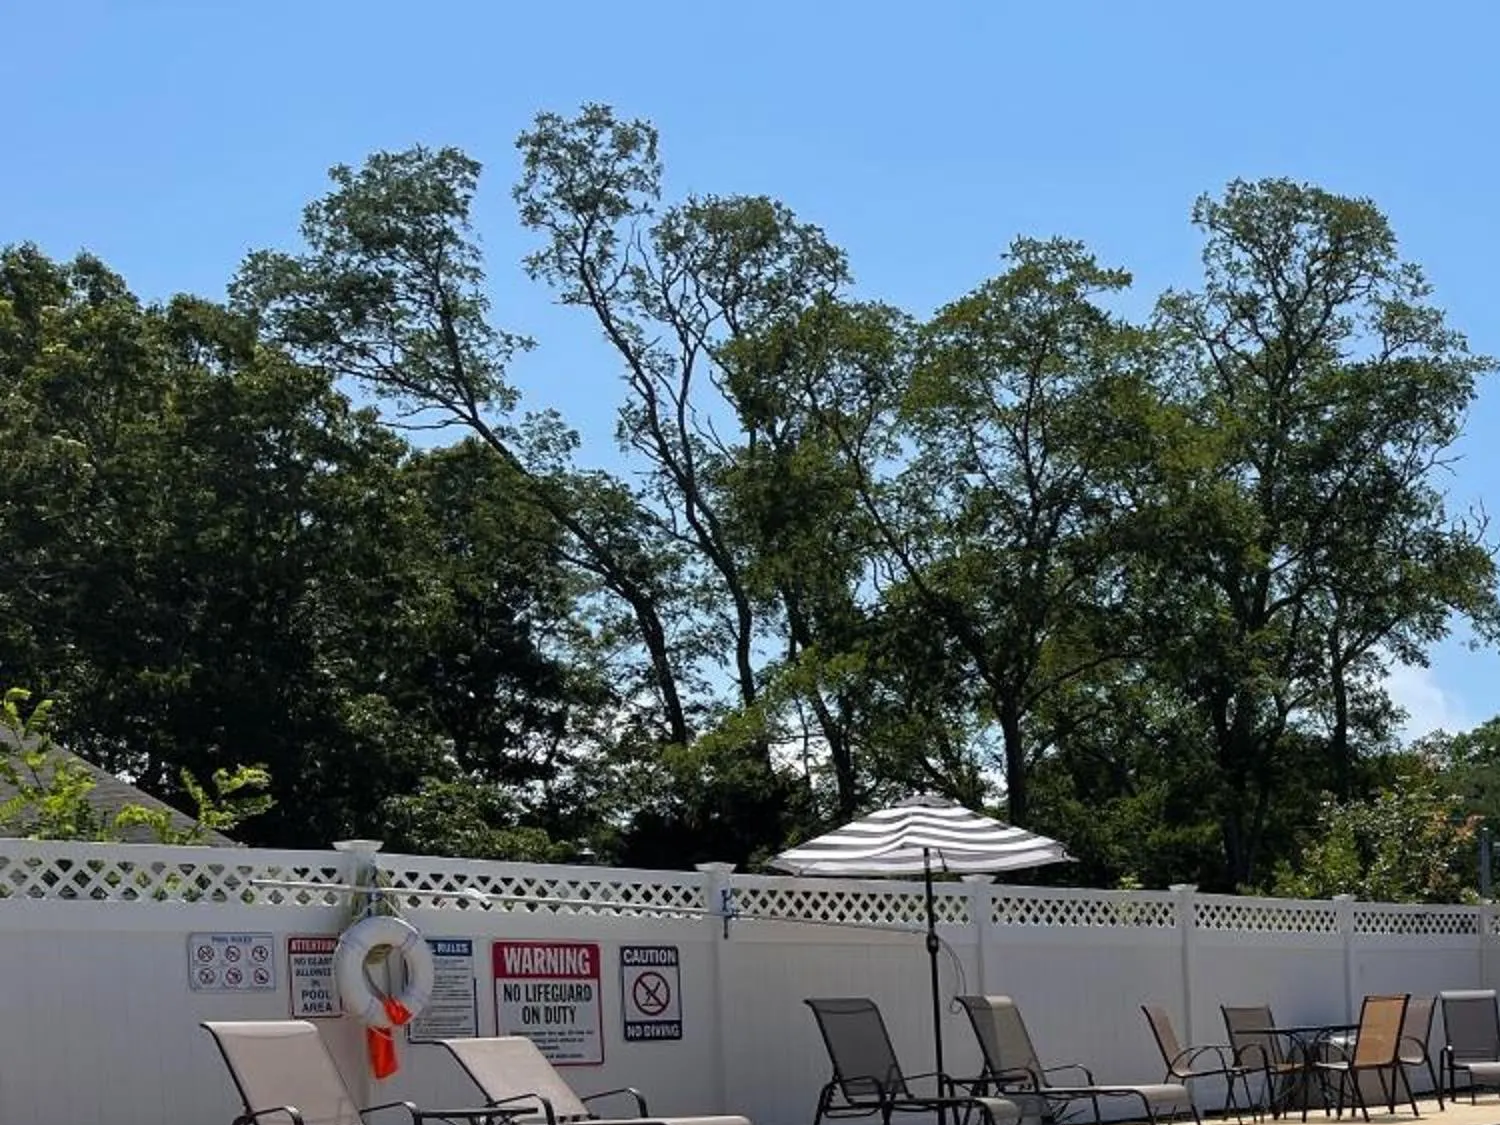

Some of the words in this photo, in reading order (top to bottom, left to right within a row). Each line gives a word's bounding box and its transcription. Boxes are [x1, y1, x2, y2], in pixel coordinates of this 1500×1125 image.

[503, 946, 591, 975] WARNING
[623, 948, 676, 964] CAUTION
[302, 989, 331, 1000] POOL
[503, 983, 521, 1002] NO
[525, 983, 593, 1003] LIFEGUARD
[302, 1002, 332, 1012] AREA
[522, 1005, 540, 1025] ON
[545, 1005, 577, 1025] DUTY
[627, 1025, 642, 1038] NO
[643, 1023, 680, 1038] DIVING
